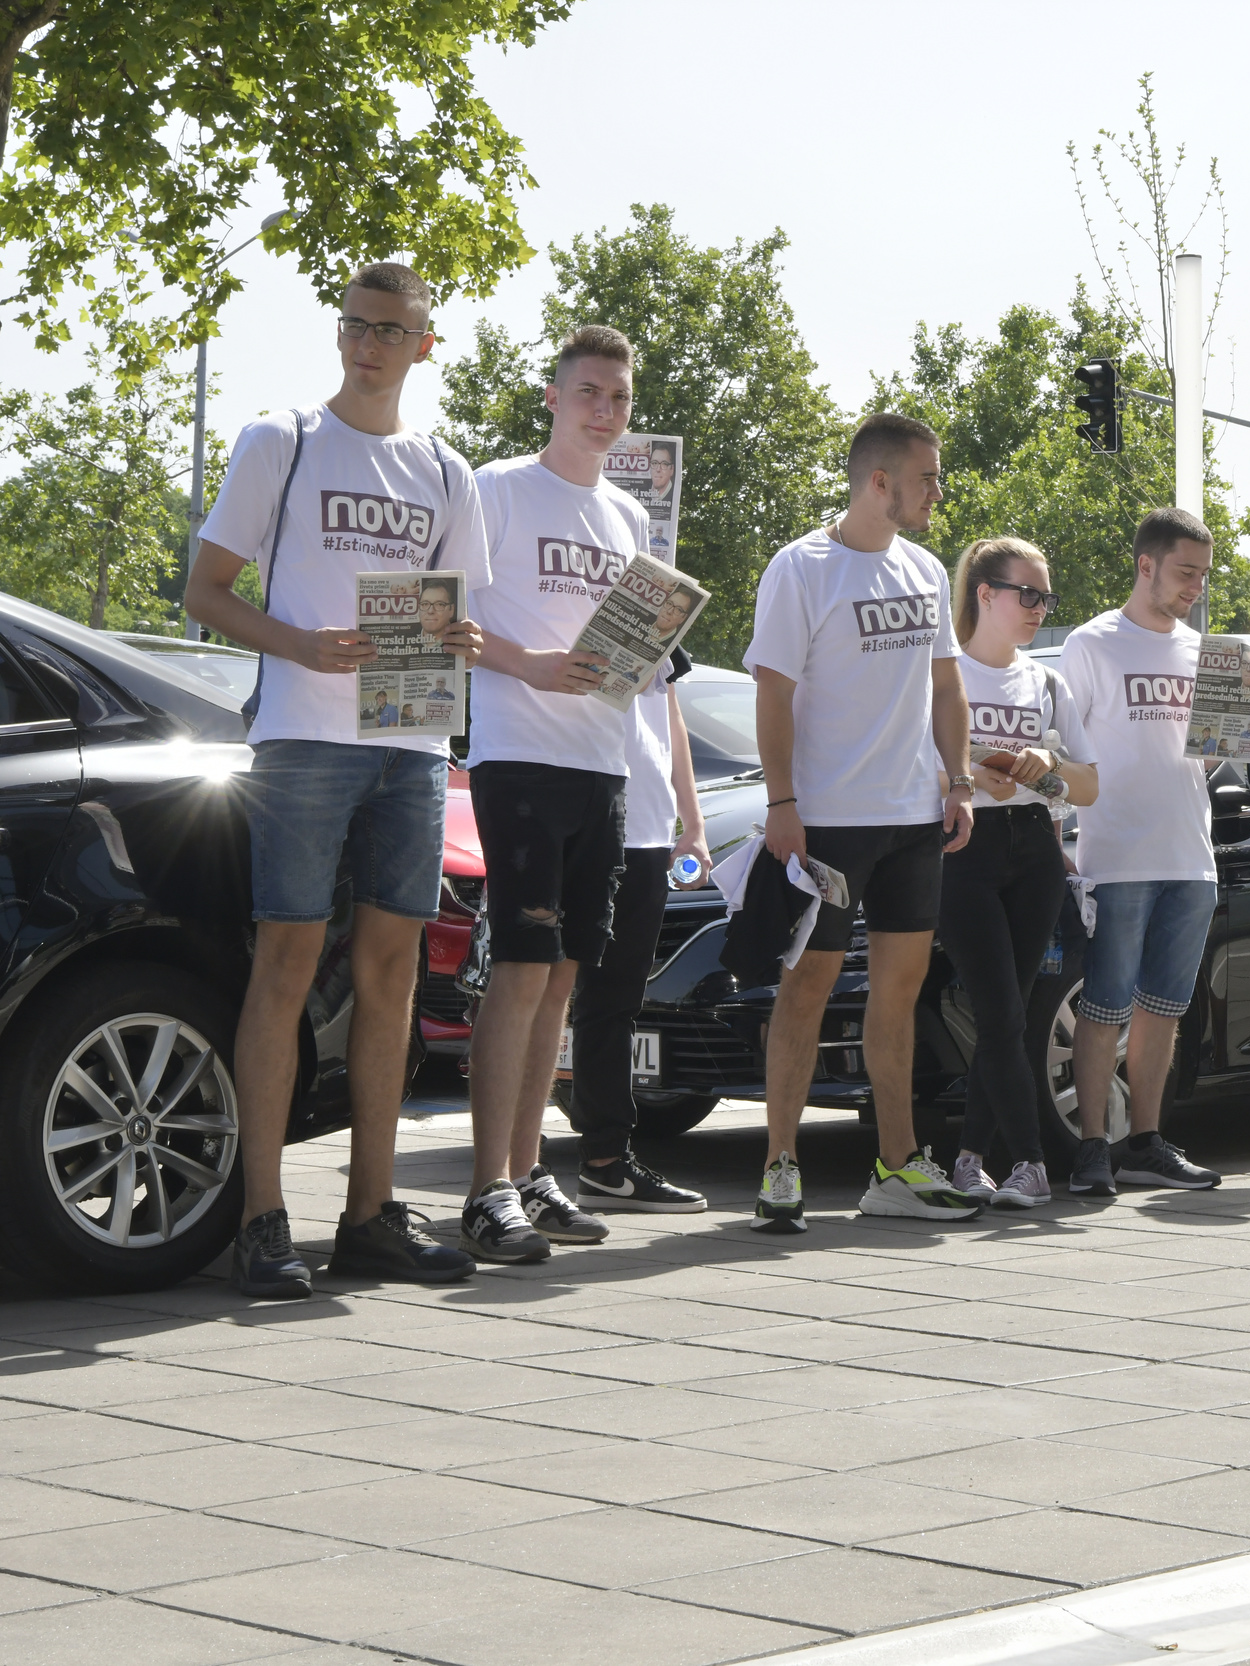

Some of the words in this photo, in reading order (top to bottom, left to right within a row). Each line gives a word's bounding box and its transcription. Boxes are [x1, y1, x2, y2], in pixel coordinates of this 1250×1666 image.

[604, 454, 649, 470] nova
[328, 496, 430, 543] nova
[544, 542, 625, 586] nova
[620, 572, 667, 608] nova
[361, 597, 418, 614] nova
[860, 597, 940, 633] nova
[604, 599, 640, 626] Uličarski
[639, 621, 661, 639] rečnik
[370, 635, 405, 645] ičarski
[406, 634, 436, 645] rečnik
[596, 608, 644, 640] predsednika
[644, 632, 667, 653] države
[376, 645, 419, 655] dsednika
[421, 644, 447, 653] drža
[1200, 653, 1240, 669] nova
[1129, 677, 1194, 703] nov
[1194, 692, 1239, 702] predsednika
[1196, 683, 1228, 693] Uličarski
